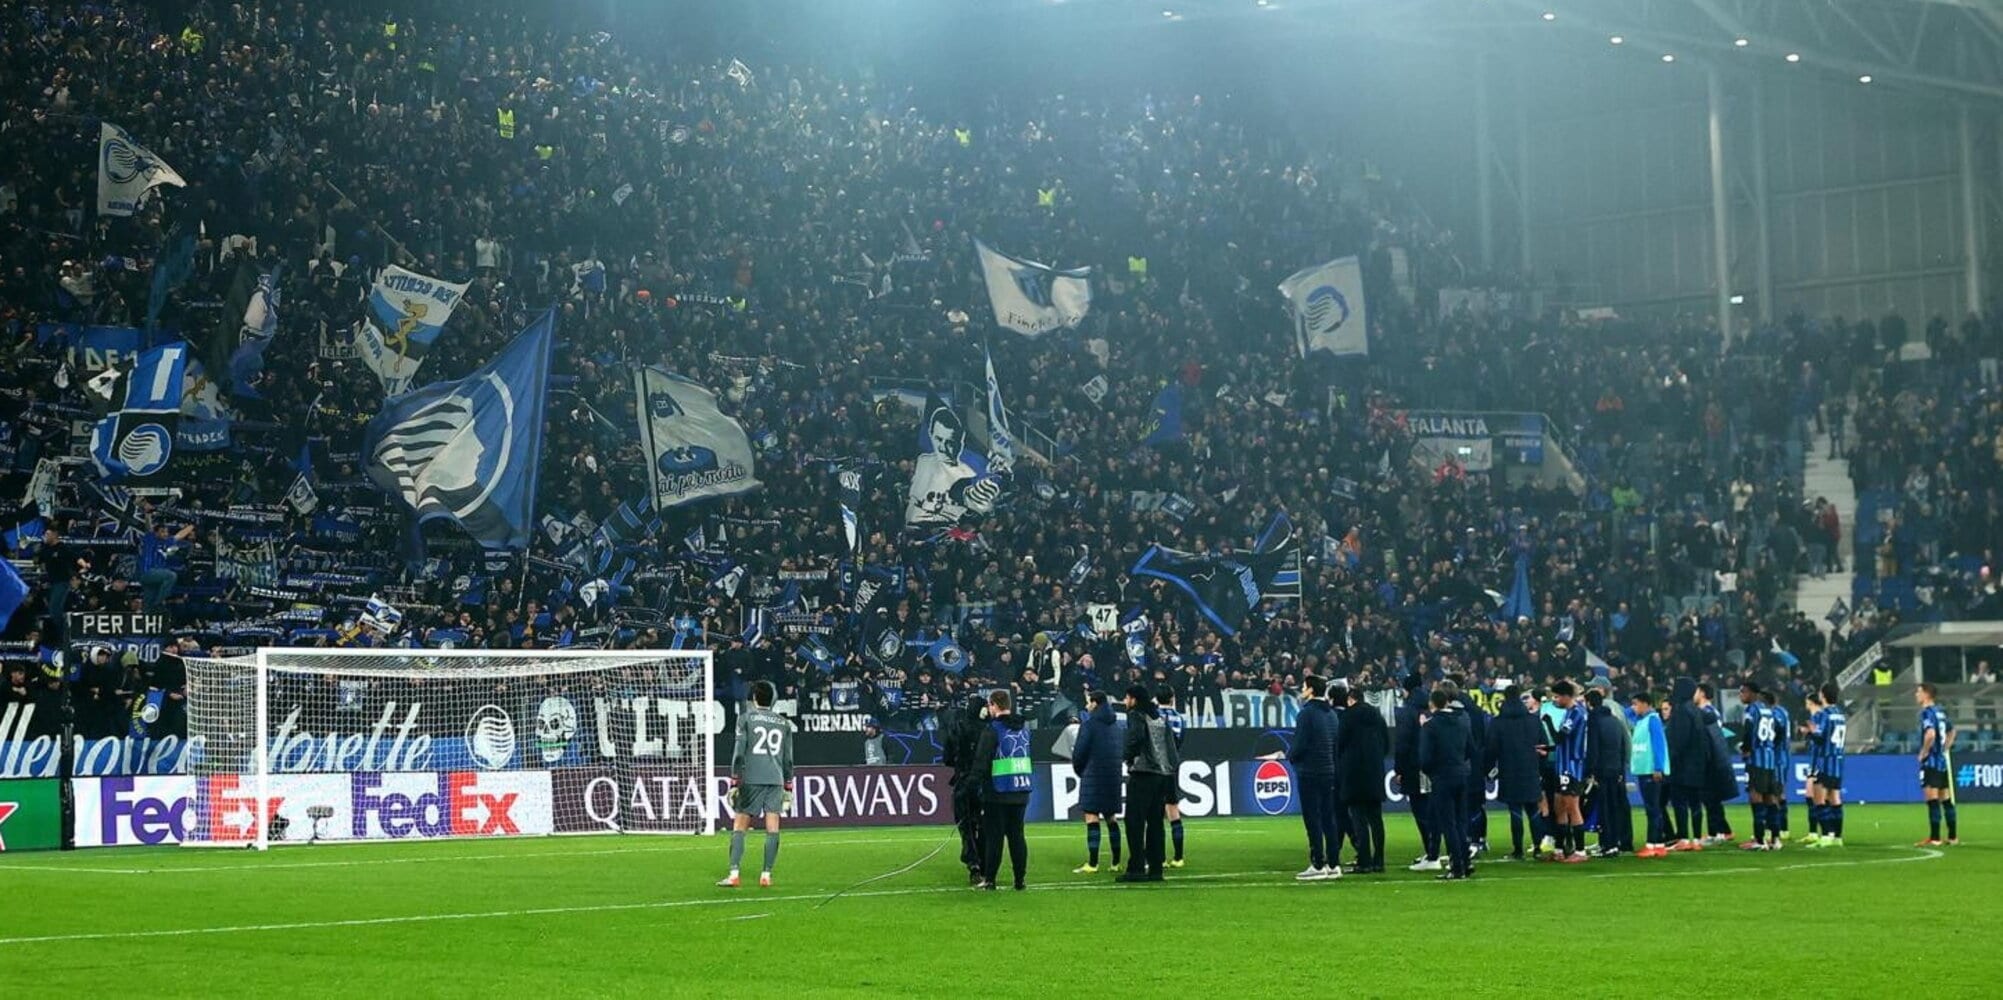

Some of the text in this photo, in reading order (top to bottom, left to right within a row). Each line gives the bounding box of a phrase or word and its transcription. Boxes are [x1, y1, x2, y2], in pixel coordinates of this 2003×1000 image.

[1407, 417, 1489, 435] TALANTA
[82, 615, 123, 634] PER
[1095, 608, 1112, 622] 47
[752, 726, 783, 756] 29
[1256, 782, 1290, 793] PEPSI
[1957, 764, 2003, 787] #FOO
[584, 773, 938, 832] QATAR IRWAYS
[1051, 760, 1232, 820] PSI
[101, 773, 284, 846] FedEx
[352, 770, 520, 837] FedEx
